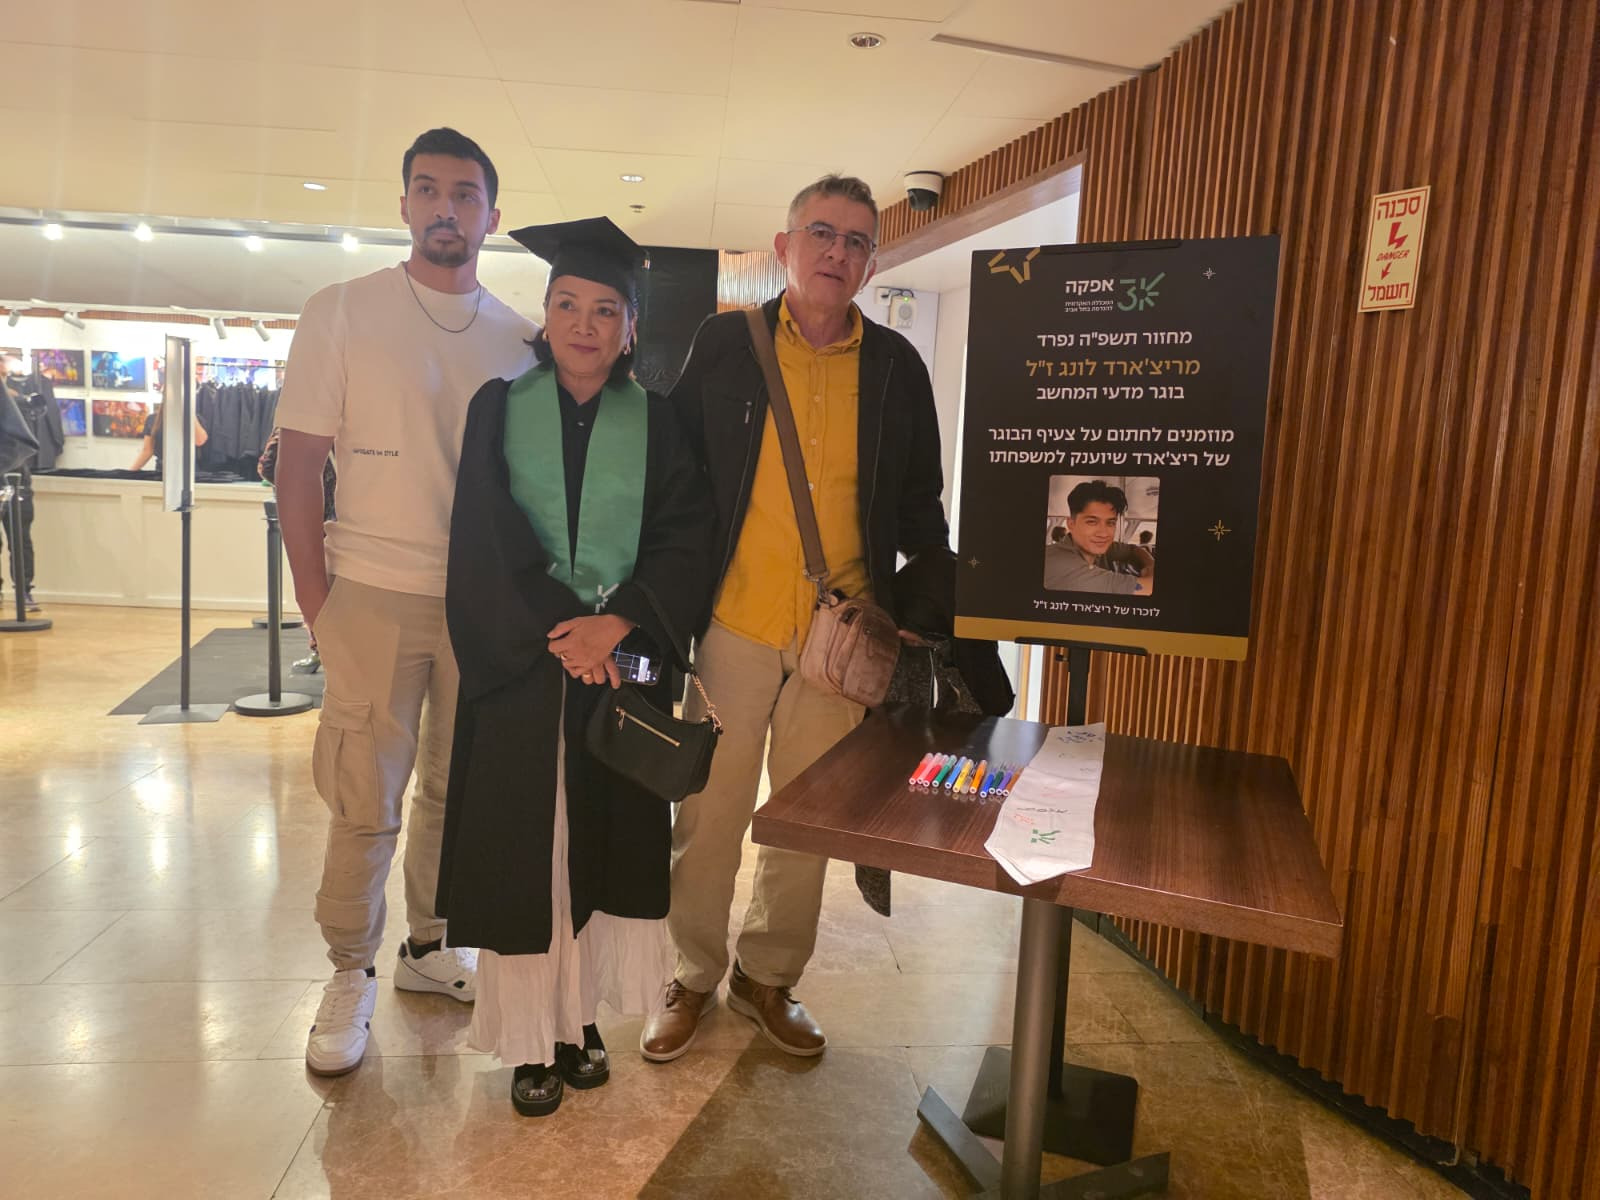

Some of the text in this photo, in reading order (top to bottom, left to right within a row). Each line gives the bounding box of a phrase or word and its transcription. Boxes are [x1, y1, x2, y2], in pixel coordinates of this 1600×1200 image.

[1377, 196, 1421, 220] סכנה
[1376, 249, 1410, 261] DANGER
[1065, 278, 1114, 296] אפקה
[1367, 282, 1409, 301] חשמל
[1036, 331, 1193, 347] מחזור תשפ"ה נפרד
[1025, 357, 1201, 377] מריצ'ארד לונג ז"ל
[1036, 386, 1185, 400] בוגר מדעי המחשב
[988, 426, 1235, 444] מוזמנים לחתום על צעיף הבוגר
[989, 449, 1231, 467] של ריצ'ארד שיוענק למשפחתו
[1049, 601, 1070, 611] לונג
[1113, 604, 1130, 615] של
[1132, 607, 1161, 617] לזכרו
